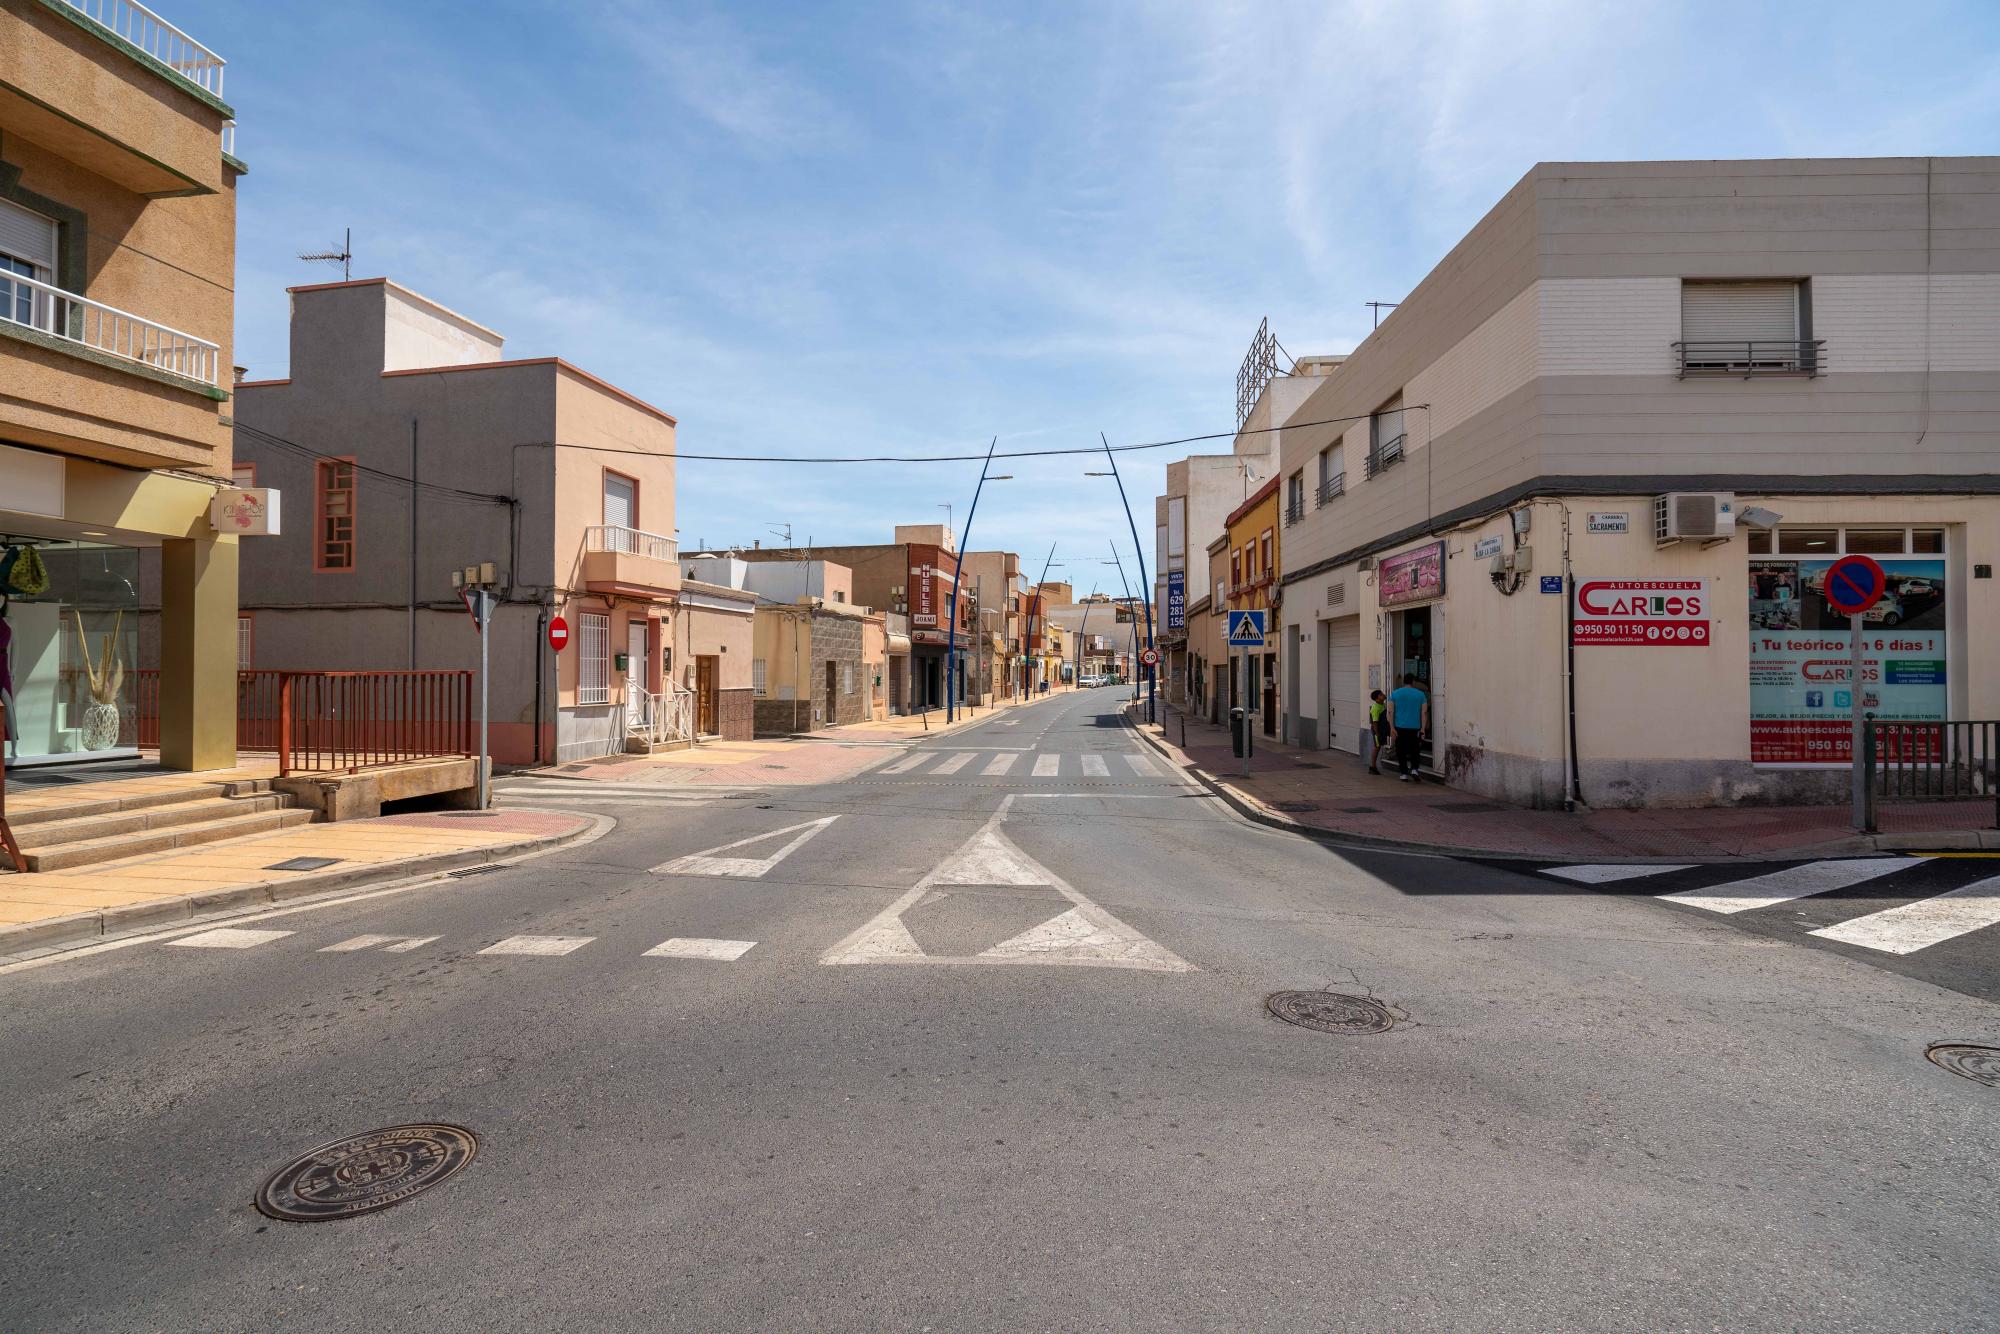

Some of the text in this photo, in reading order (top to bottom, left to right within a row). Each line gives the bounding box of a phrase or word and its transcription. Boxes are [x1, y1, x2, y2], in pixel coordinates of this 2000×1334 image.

[922, 564, 930, 614] MUEBLES
[1170, 596, 1184, 604] 629
[1579, 582, 1701, 616] CARLOS
[1170, 606, 1184, 616] 281
[1170, 618, 1184, 626] 156
[1585, 625, 1644, 634] 950 50 11 50
[1762, 639, 1781, 650] Tu
[1787, 639, 1844, 650] teórico
[1874, 639, 1884, 650] 6
[1890, 638, 1923, 650] días
[1808, 741, 1831, 750] 950
[1836, 741, 1850, 750] 50
[343, 1184, 423, 1212] ALMERIA
